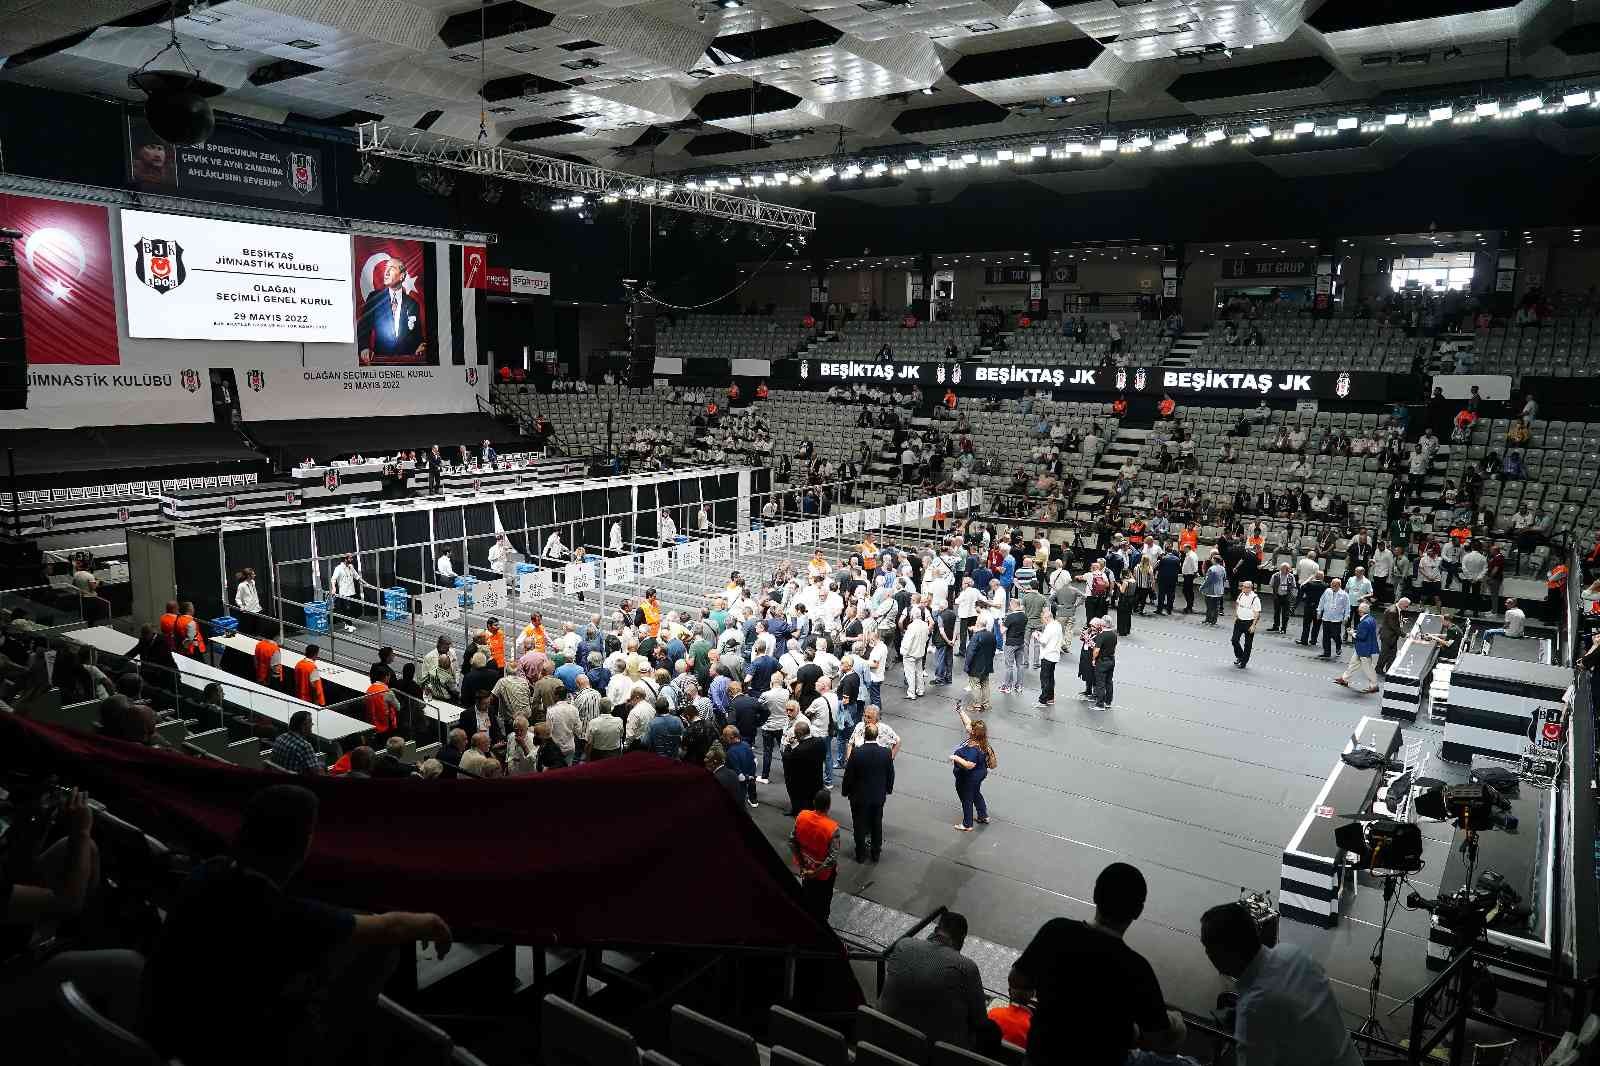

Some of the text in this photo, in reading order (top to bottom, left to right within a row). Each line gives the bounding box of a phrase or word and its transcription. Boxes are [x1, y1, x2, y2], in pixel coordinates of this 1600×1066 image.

[210, 156, 222, 166] VE
[245, 163, 284, 176] ZAMANDA
[143, 242, 175, 256] BJK
[242, 248, 294, 260] BEŞİKTAŞ
[216, 256, 319, 272] JİMNASTİK KULÜBÜ
[253, 283, 296, 294] OLAĞAN
[216, 292, 333, 306] SEÇİMLİ GENEL KURUL
[249, 313, 282, 322] MAYIS
[285, 314, 308, 323] 2022
[303, 370, 434, 380] OLAĞAN SEÇİMLİ GENEL KURUL
[820, 361, 894, 380] BEŞİKTAŞ
[898, 365, 920, 379] JK
[975, 365, 1064, 386] BEŞİKTAŞ
[1070, 369, 1097, 385] JK
[27, 371, 108, 387] JİMNASTİK
[113, 372, 172, 387] KULÜBÜ
[343, 381, 400, 390] 29 MAYIS 2022
[1163, 369, 1273, 393] BEŞİKTAŞ
[1278, 374, 1312, 391] JK
